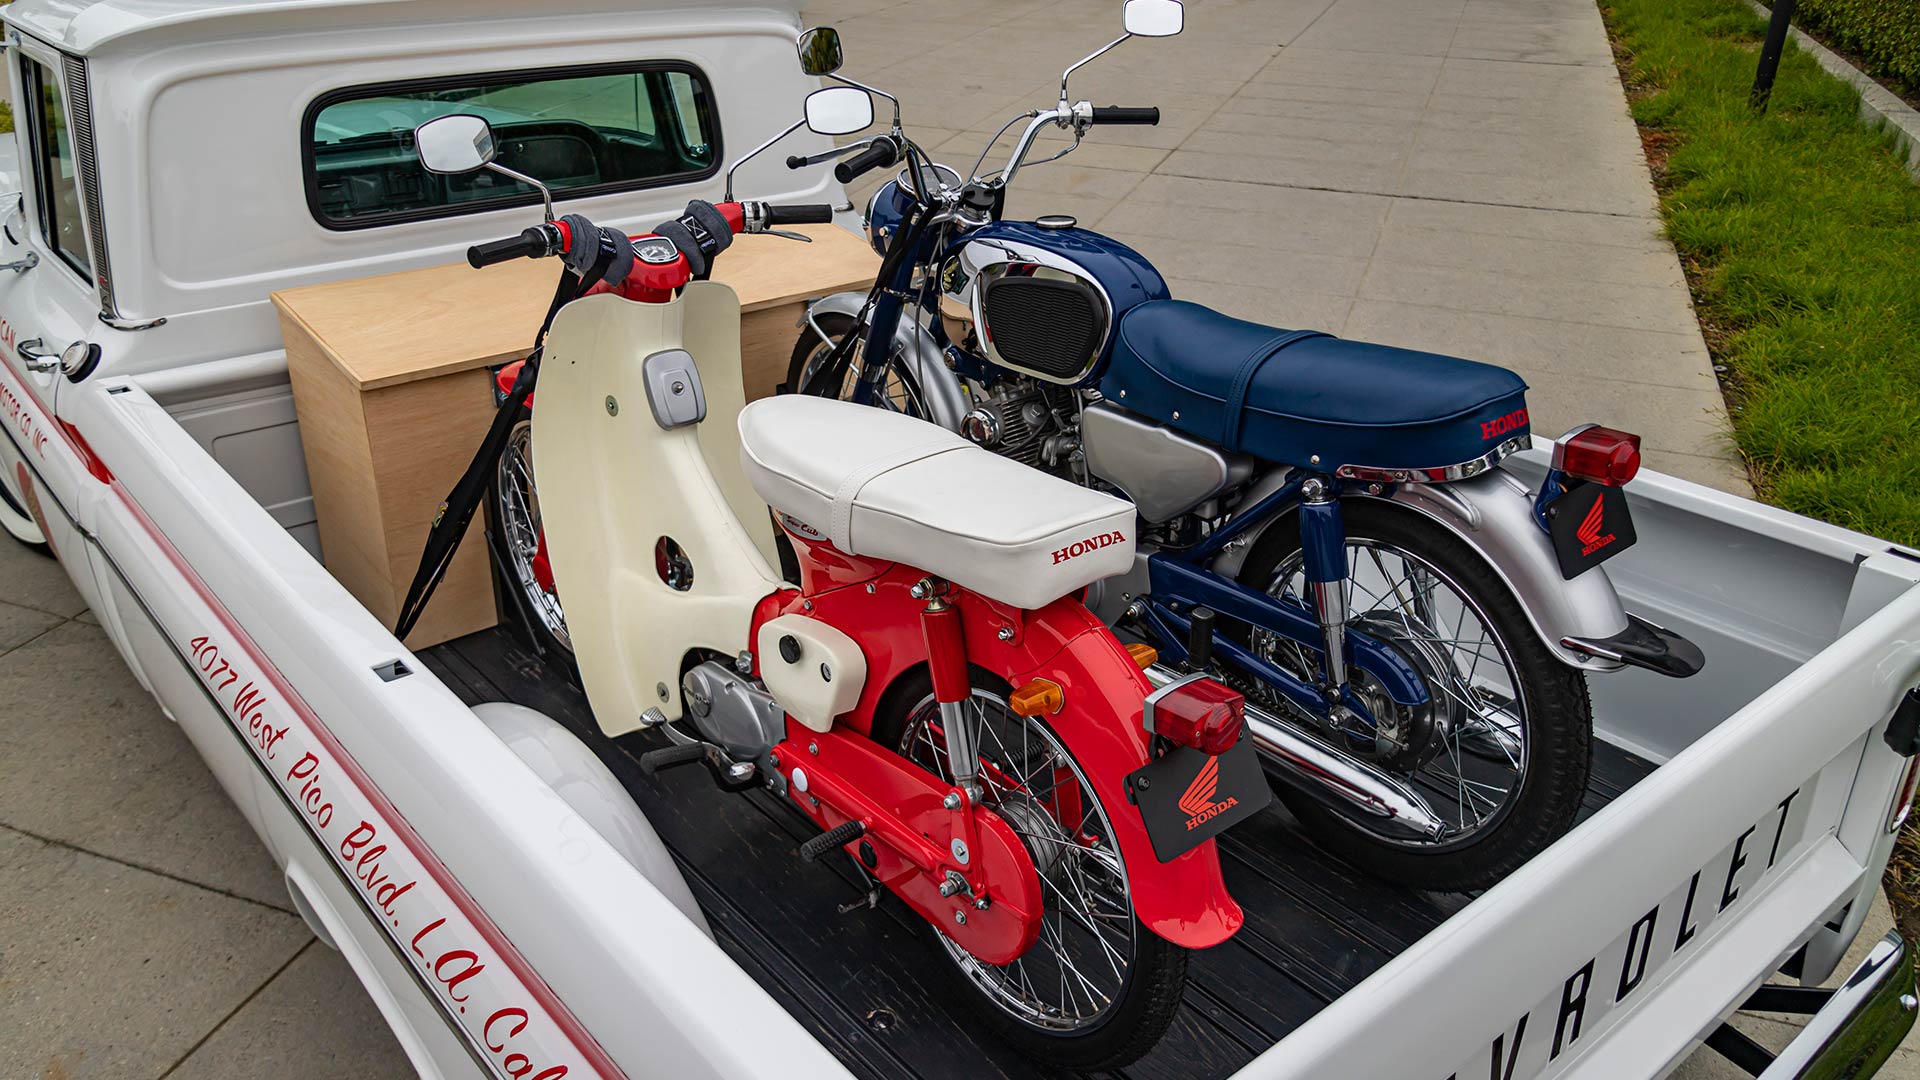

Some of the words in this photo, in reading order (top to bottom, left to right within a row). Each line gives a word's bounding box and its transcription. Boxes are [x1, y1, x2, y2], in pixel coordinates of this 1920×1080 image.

[0, 319, 16, 353] CAN
[800, 523, 819, 537] Cub
[1581, 533, 1616, 557] HONDA
[1051, 530, 1126, 566] HONDA
[190, 636, 239, 692] 4077
[233, 681, 291, 760] West
[286, 751, 334, 829] Pico
[340, 820, 417, 928] Blvd.
[1185, 796, 1239, 831] HONDA
[1446, 787, 1801, 1080] VROLET
